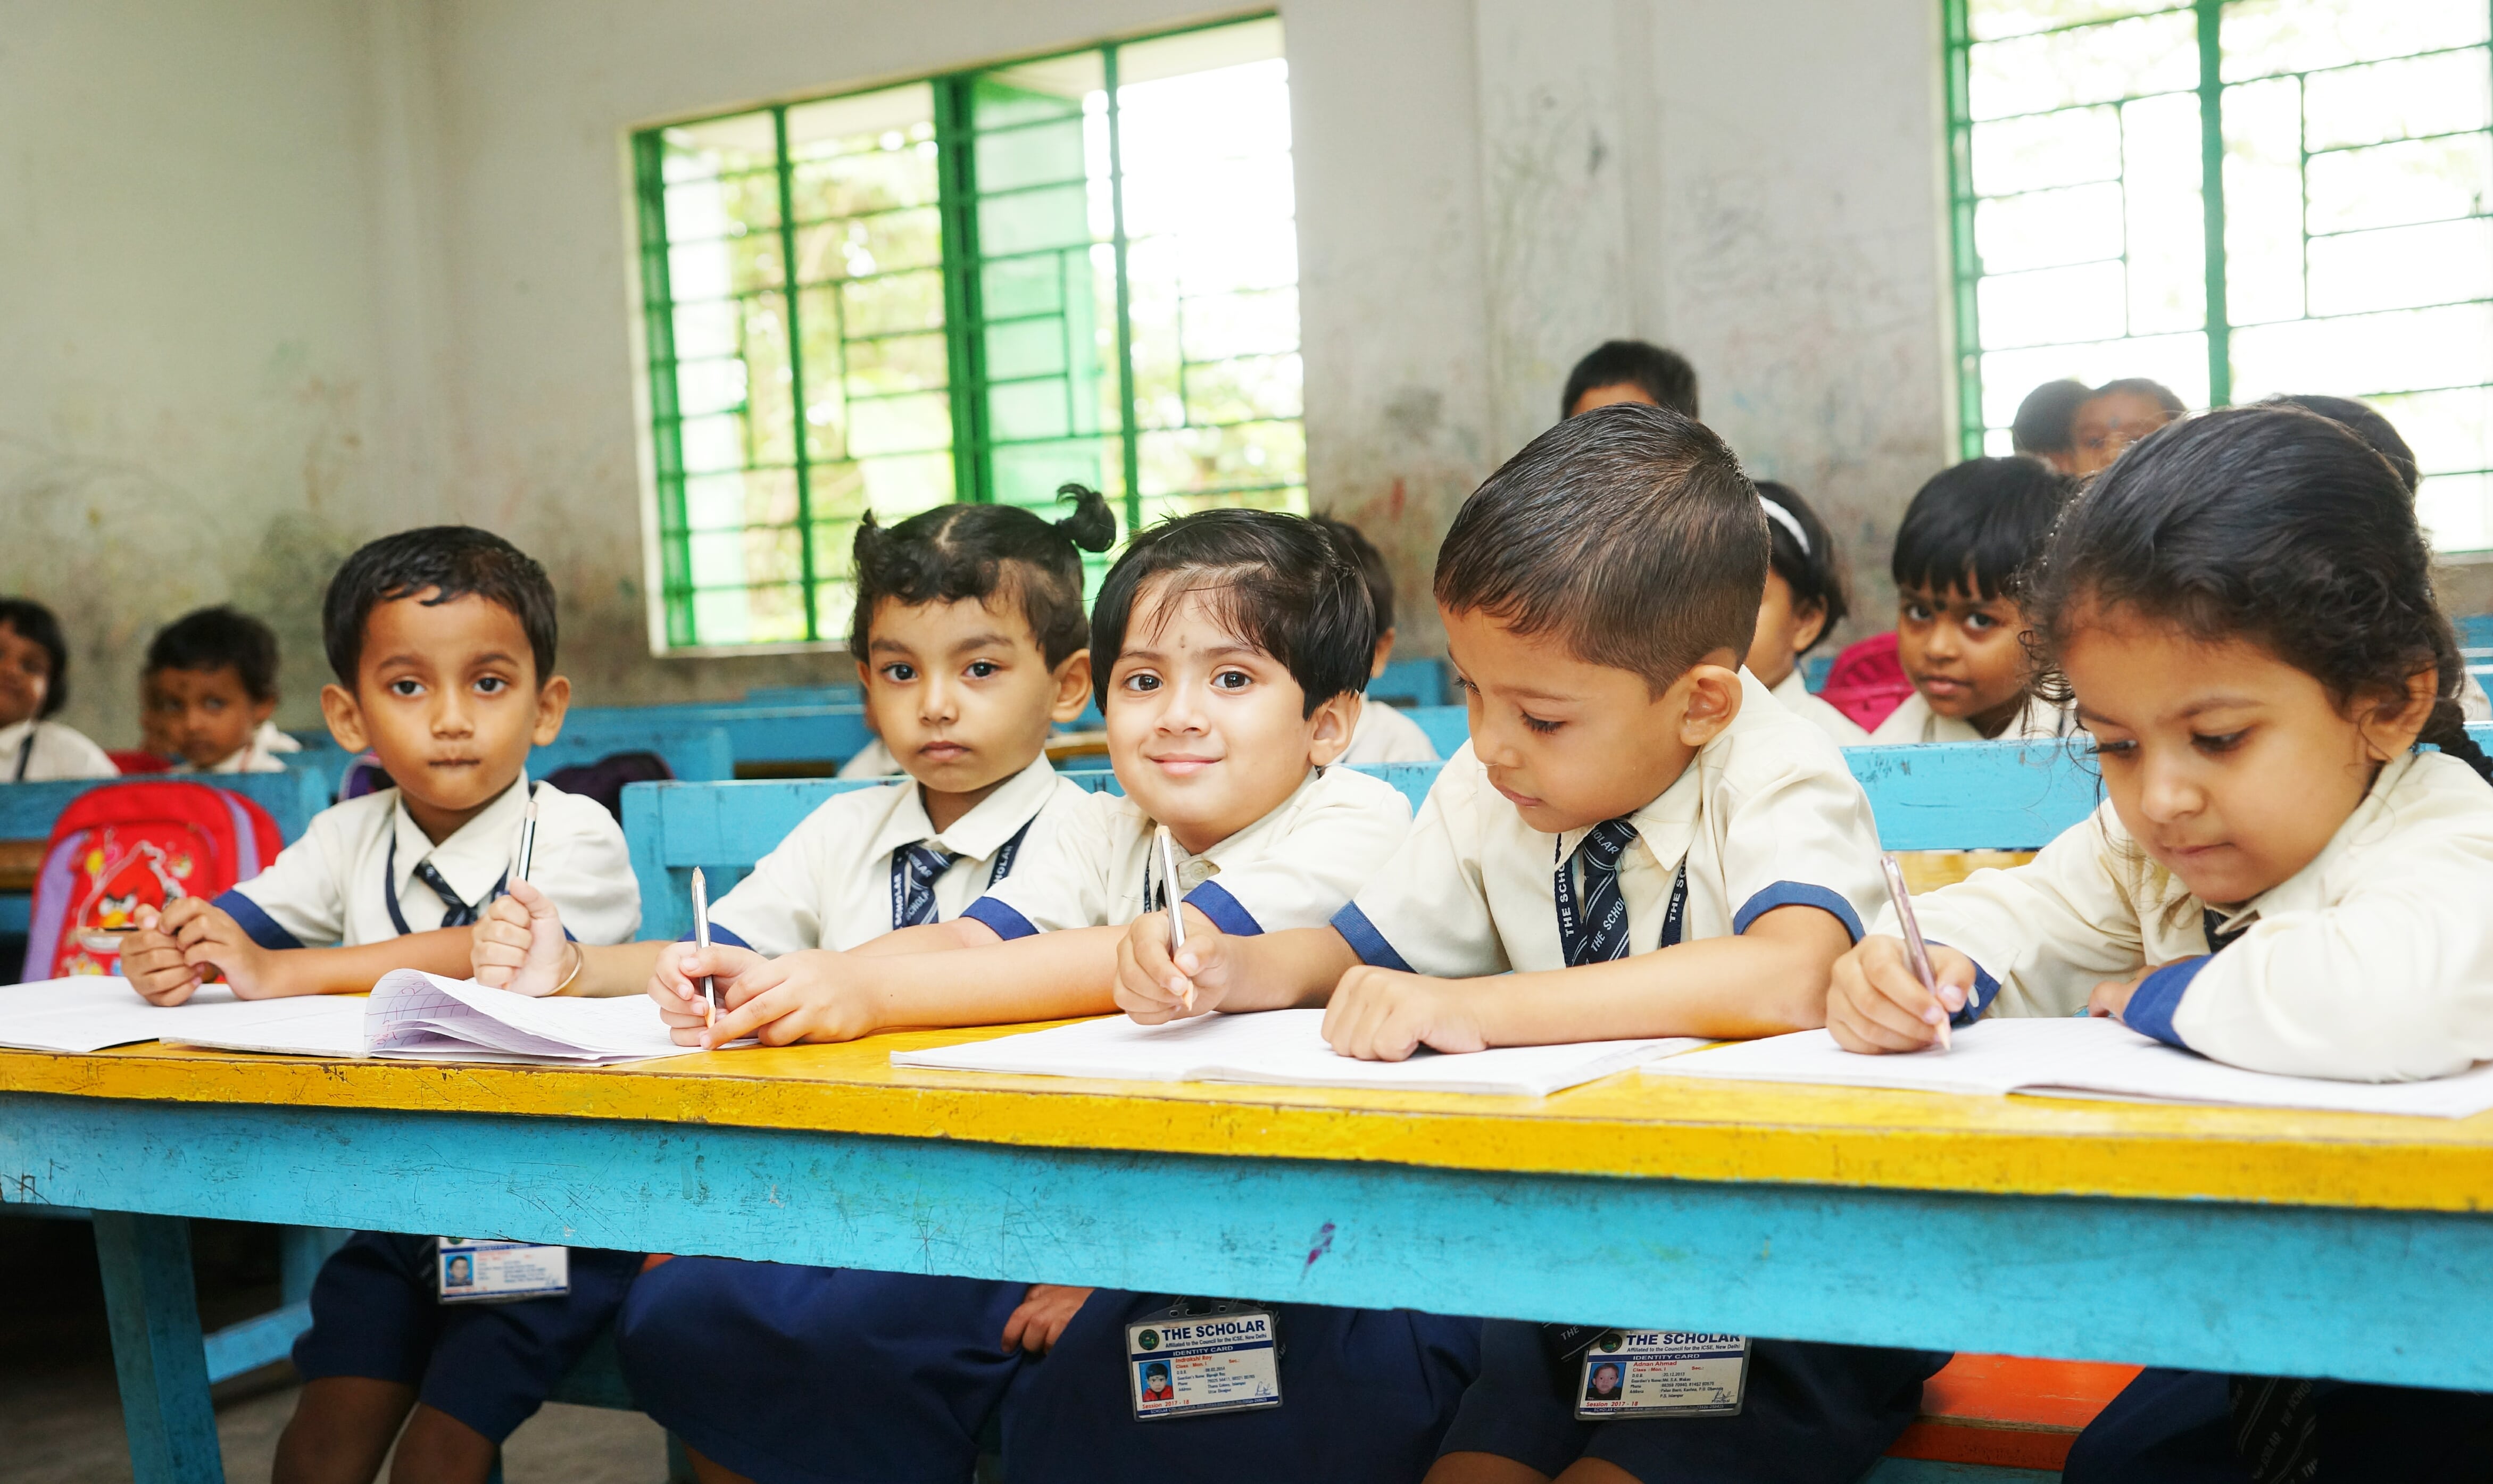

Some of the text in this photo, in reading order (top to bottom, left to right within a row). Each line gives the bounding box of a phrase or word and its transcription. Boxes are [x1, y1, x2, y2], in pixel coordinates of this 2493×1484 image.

[1669, 893, 1681, 923] THE
[1562, 906, 1574, 937] THE
[1591, 931, 1605, 952] THE
[1161, 1320, 1266, 1341] THE SCHOLAR
[1560, 1325, 1580, 1340] THE
[1626, 1333, 1740, 1346] THE SCHOLAR
[1173, 1348, 1209, 1356] IDENTITY
